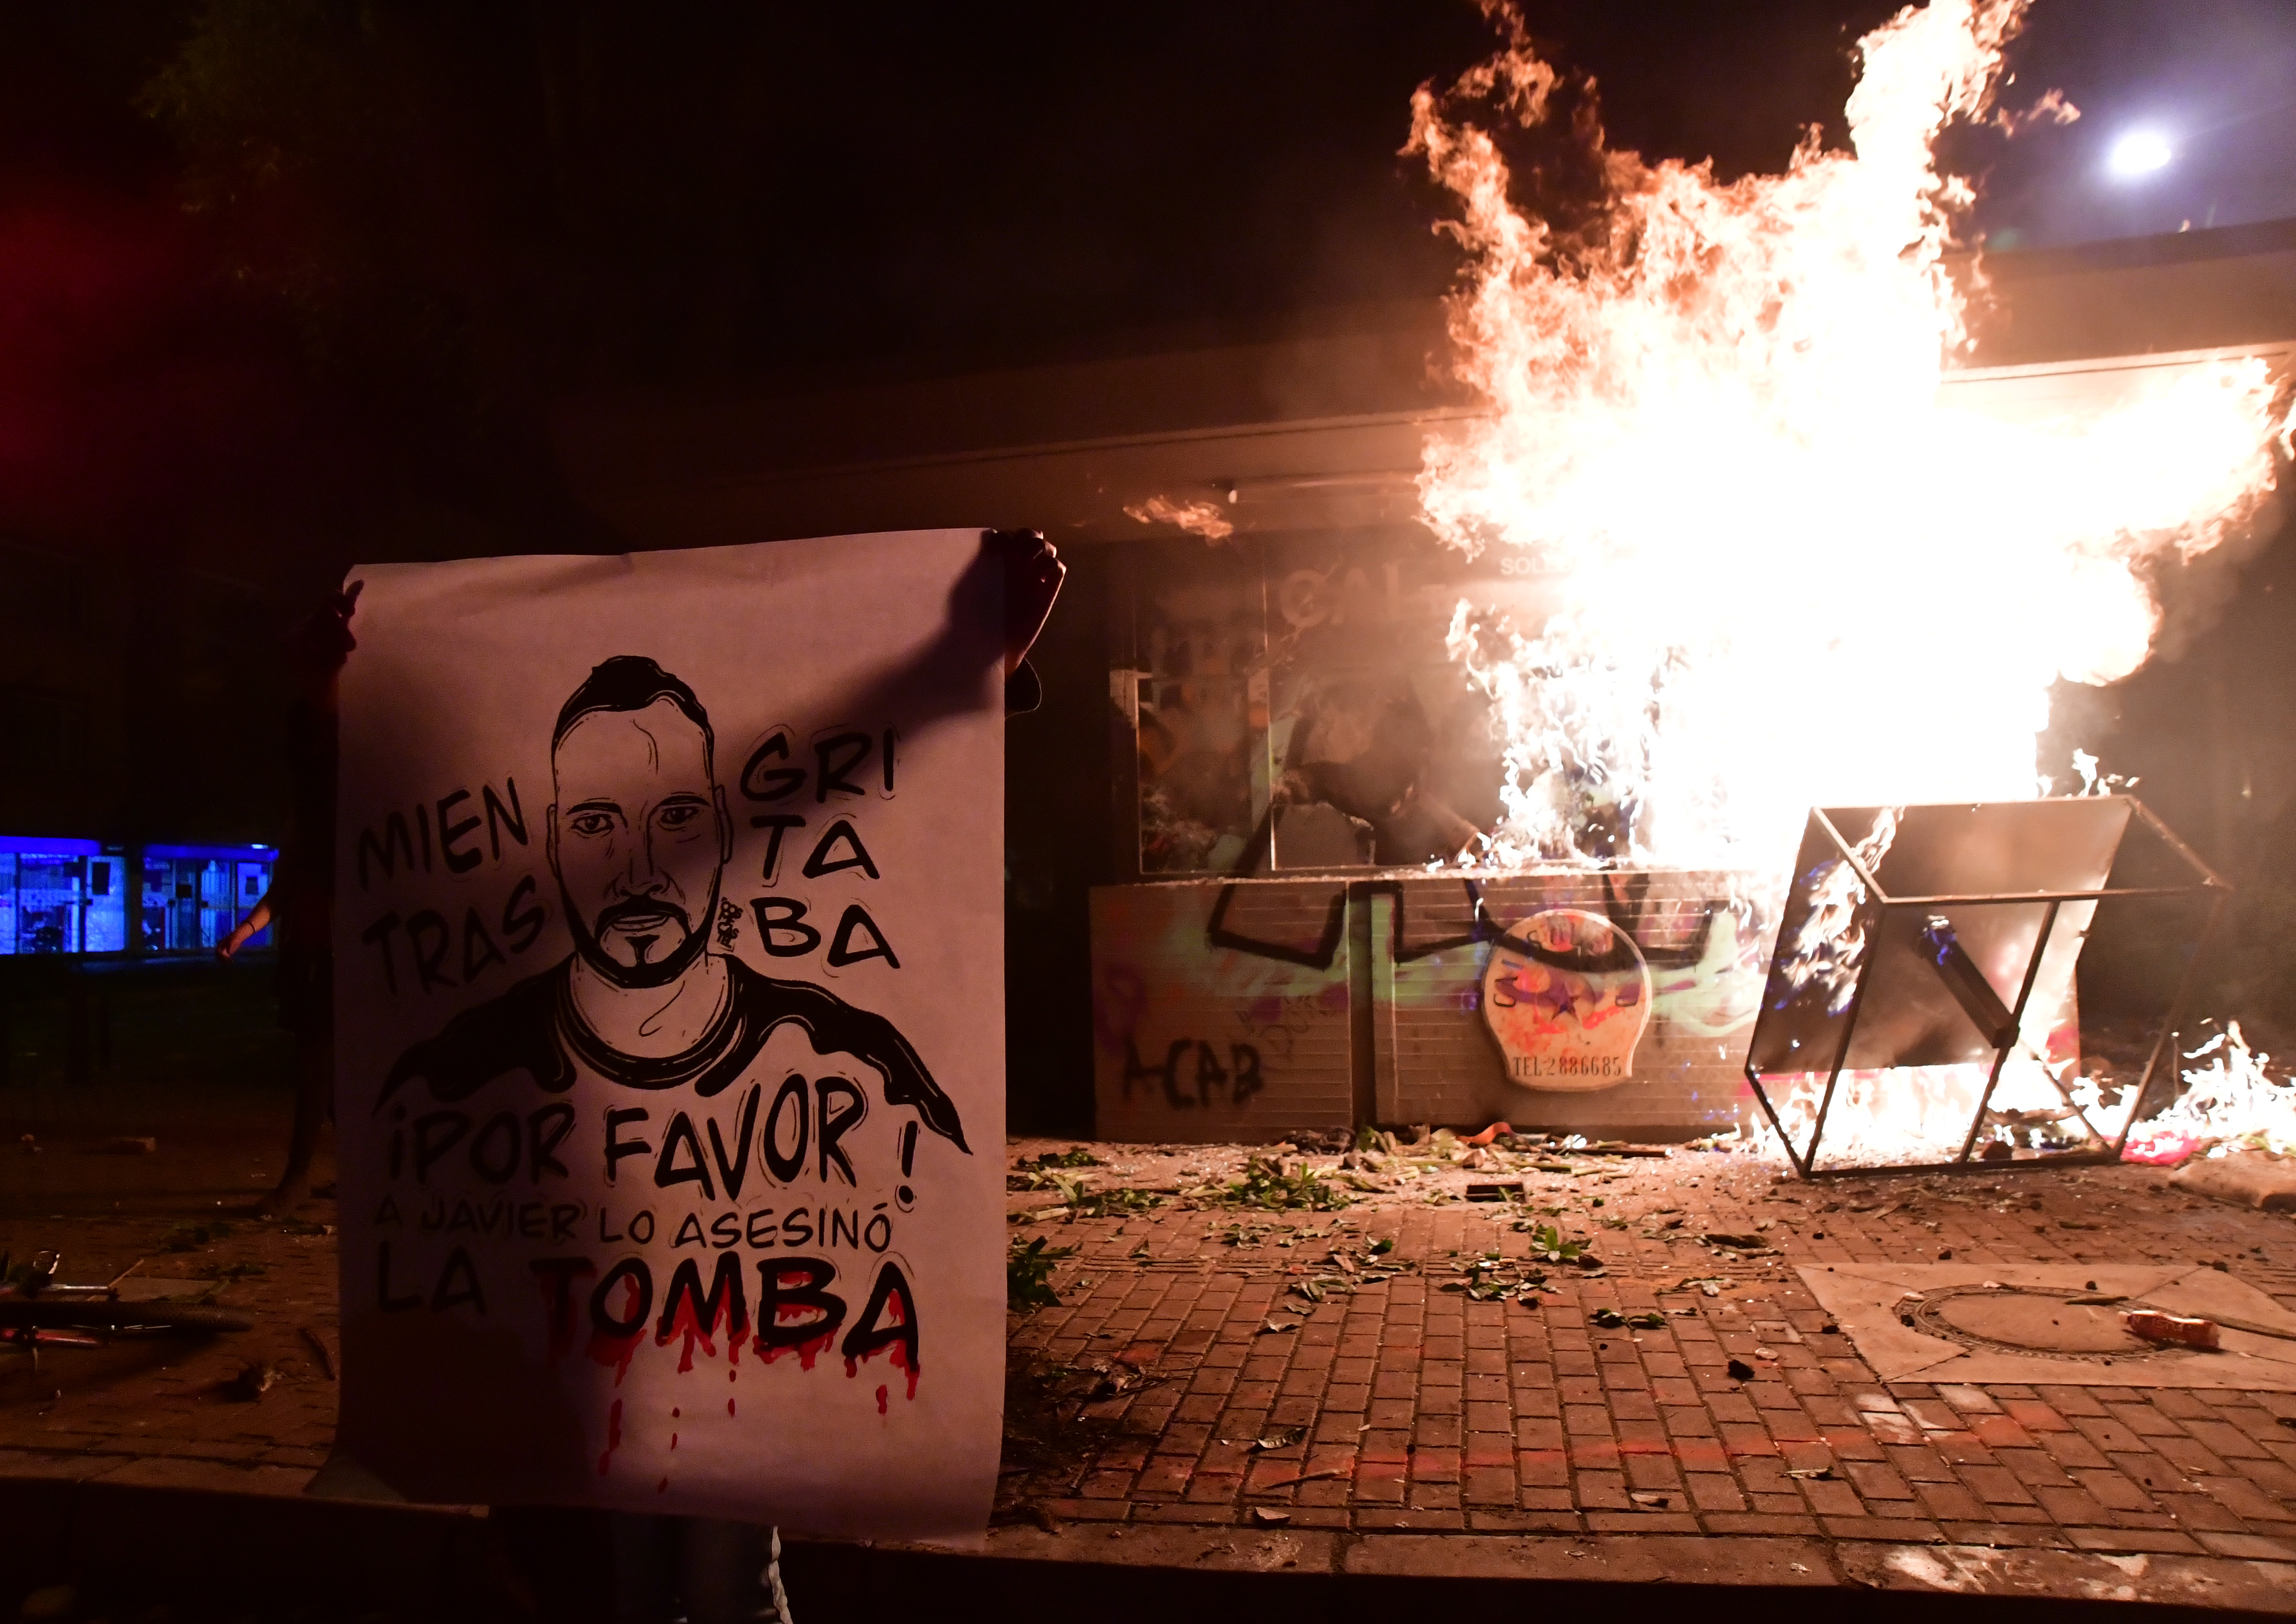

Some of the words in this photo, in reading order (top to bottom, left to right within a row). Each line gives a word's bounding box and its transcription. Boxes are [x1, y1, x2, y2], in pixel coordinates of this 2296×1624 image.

[740, 728, 894, 803] GRI
[357, 777, 528, 891] MIEN
[749, 815, 880, 880] TA
[360, 875, 545, 997] TRAS
[749, 897, 901, 969] BA
[374, 1194, 403, 1226] A
[421, 1197, 581, 1240] JAVIER
[600, 1208, 655, 1245] LO
[674, 1203, 891, 1253] ASESINÓ
[378, 1240, 486, 1315] LA
[528, 1251, 920, 1374] TOMBA
